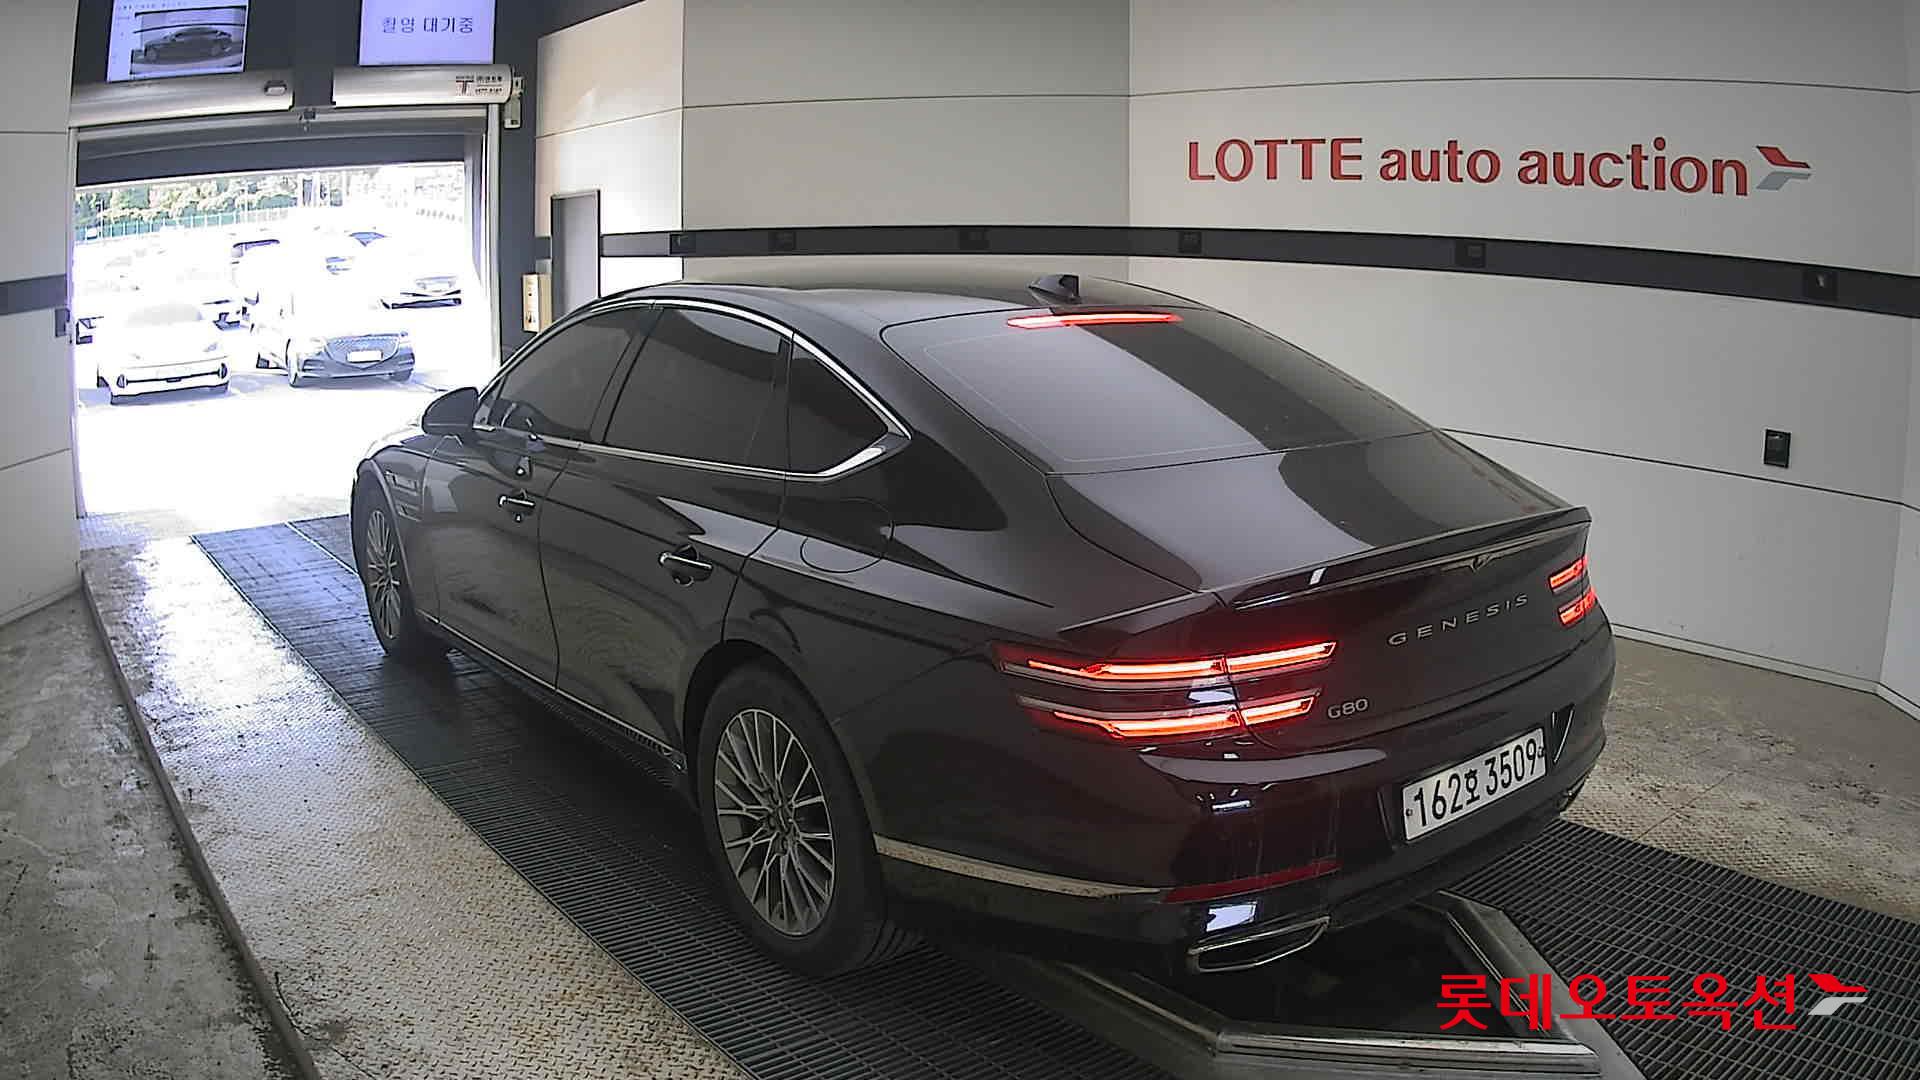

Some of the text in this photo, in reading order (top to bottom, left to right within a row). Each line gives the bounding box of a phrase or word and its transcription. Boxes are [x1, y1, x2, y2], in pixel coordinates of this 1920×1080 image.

[423, 15, 473, 34] 대기중
[1188, 137, 1748, 195] LOTTE auto auction
[1388, 593, 1529, 646] GENESIS
[1327, 698, 1369, 720] G80
[1412, 738, 1538, 828] 162호 3509
